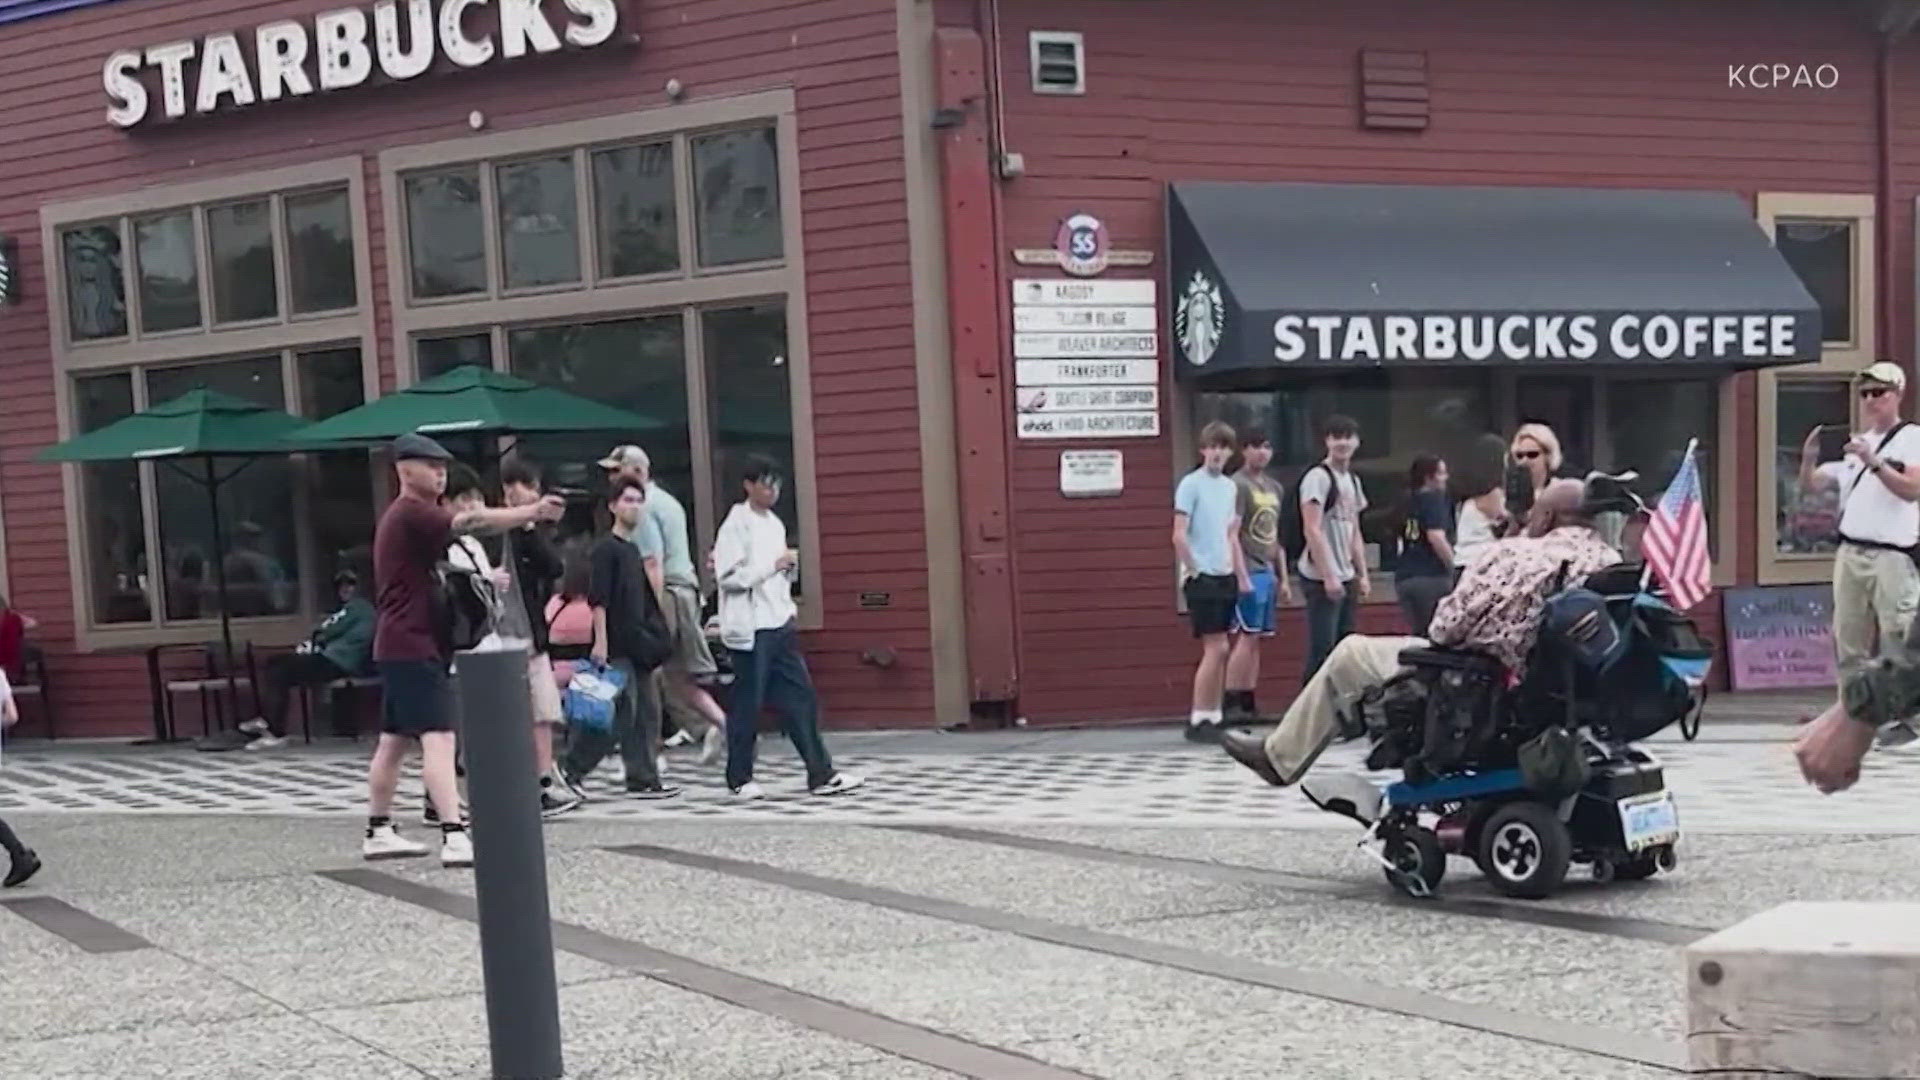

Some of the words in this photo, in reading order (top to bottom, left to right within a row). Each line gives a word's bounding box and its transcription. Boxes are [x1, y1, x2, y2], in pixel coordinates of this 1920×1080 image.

[102, 0, 618, 129] STARBUCKS
[1100, 336, 1154, 351] ARCHITECTS
[1273, 315, 1597, 361] STARBUCKS
[1608, 314, 1796, 358] COFFEE
[1087, 415, 1154, 430] ARCHITECTURE
